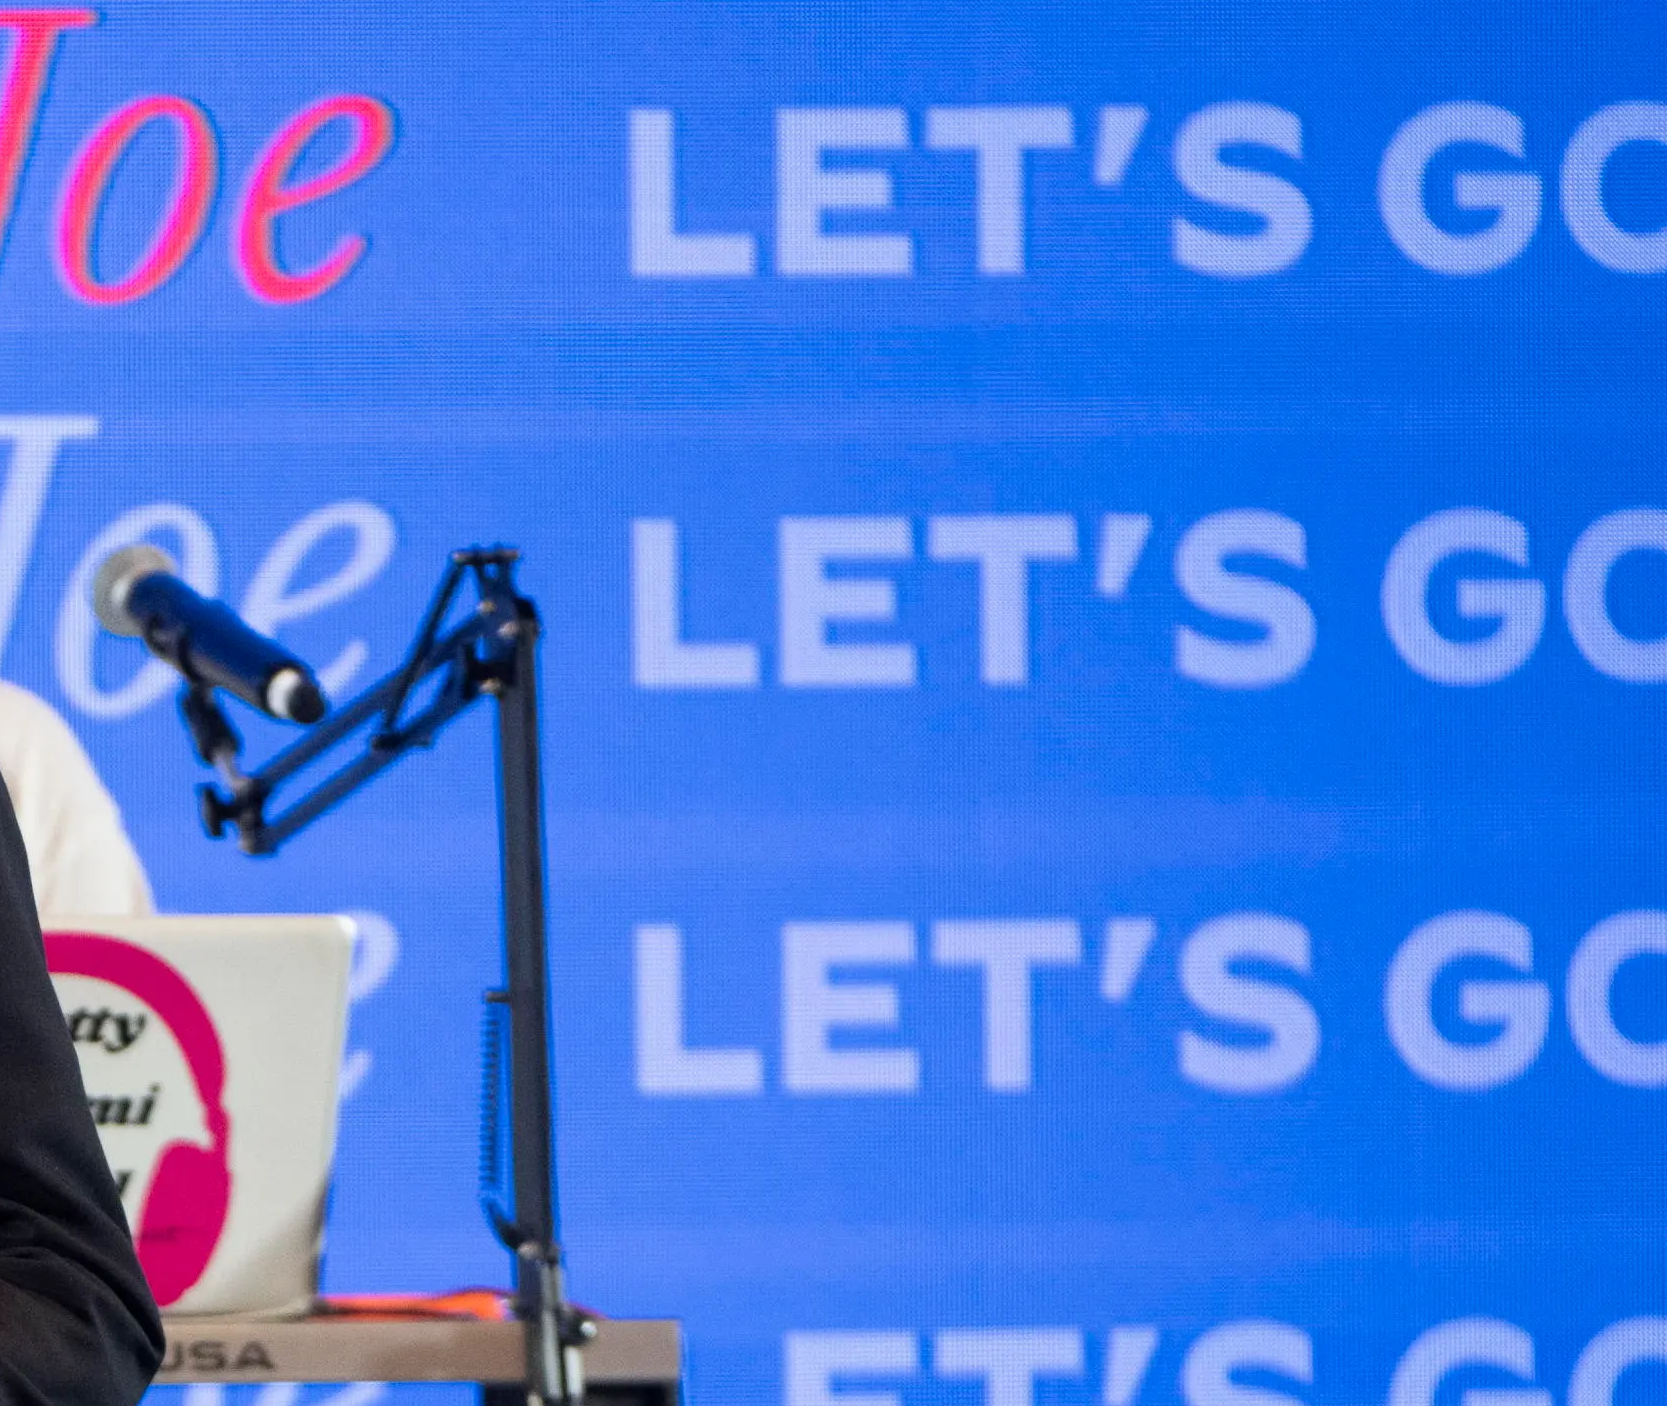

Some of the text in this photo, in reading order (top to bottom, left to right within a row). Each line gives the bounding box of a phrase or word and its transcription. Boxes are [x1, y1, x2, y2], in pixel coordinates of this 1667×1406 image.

[628, 100, 1667, 280] LET'S GO
[631, 506, 1667, 690] LET'S GO
[634, 909, 1667, 1097] LET'S GO
